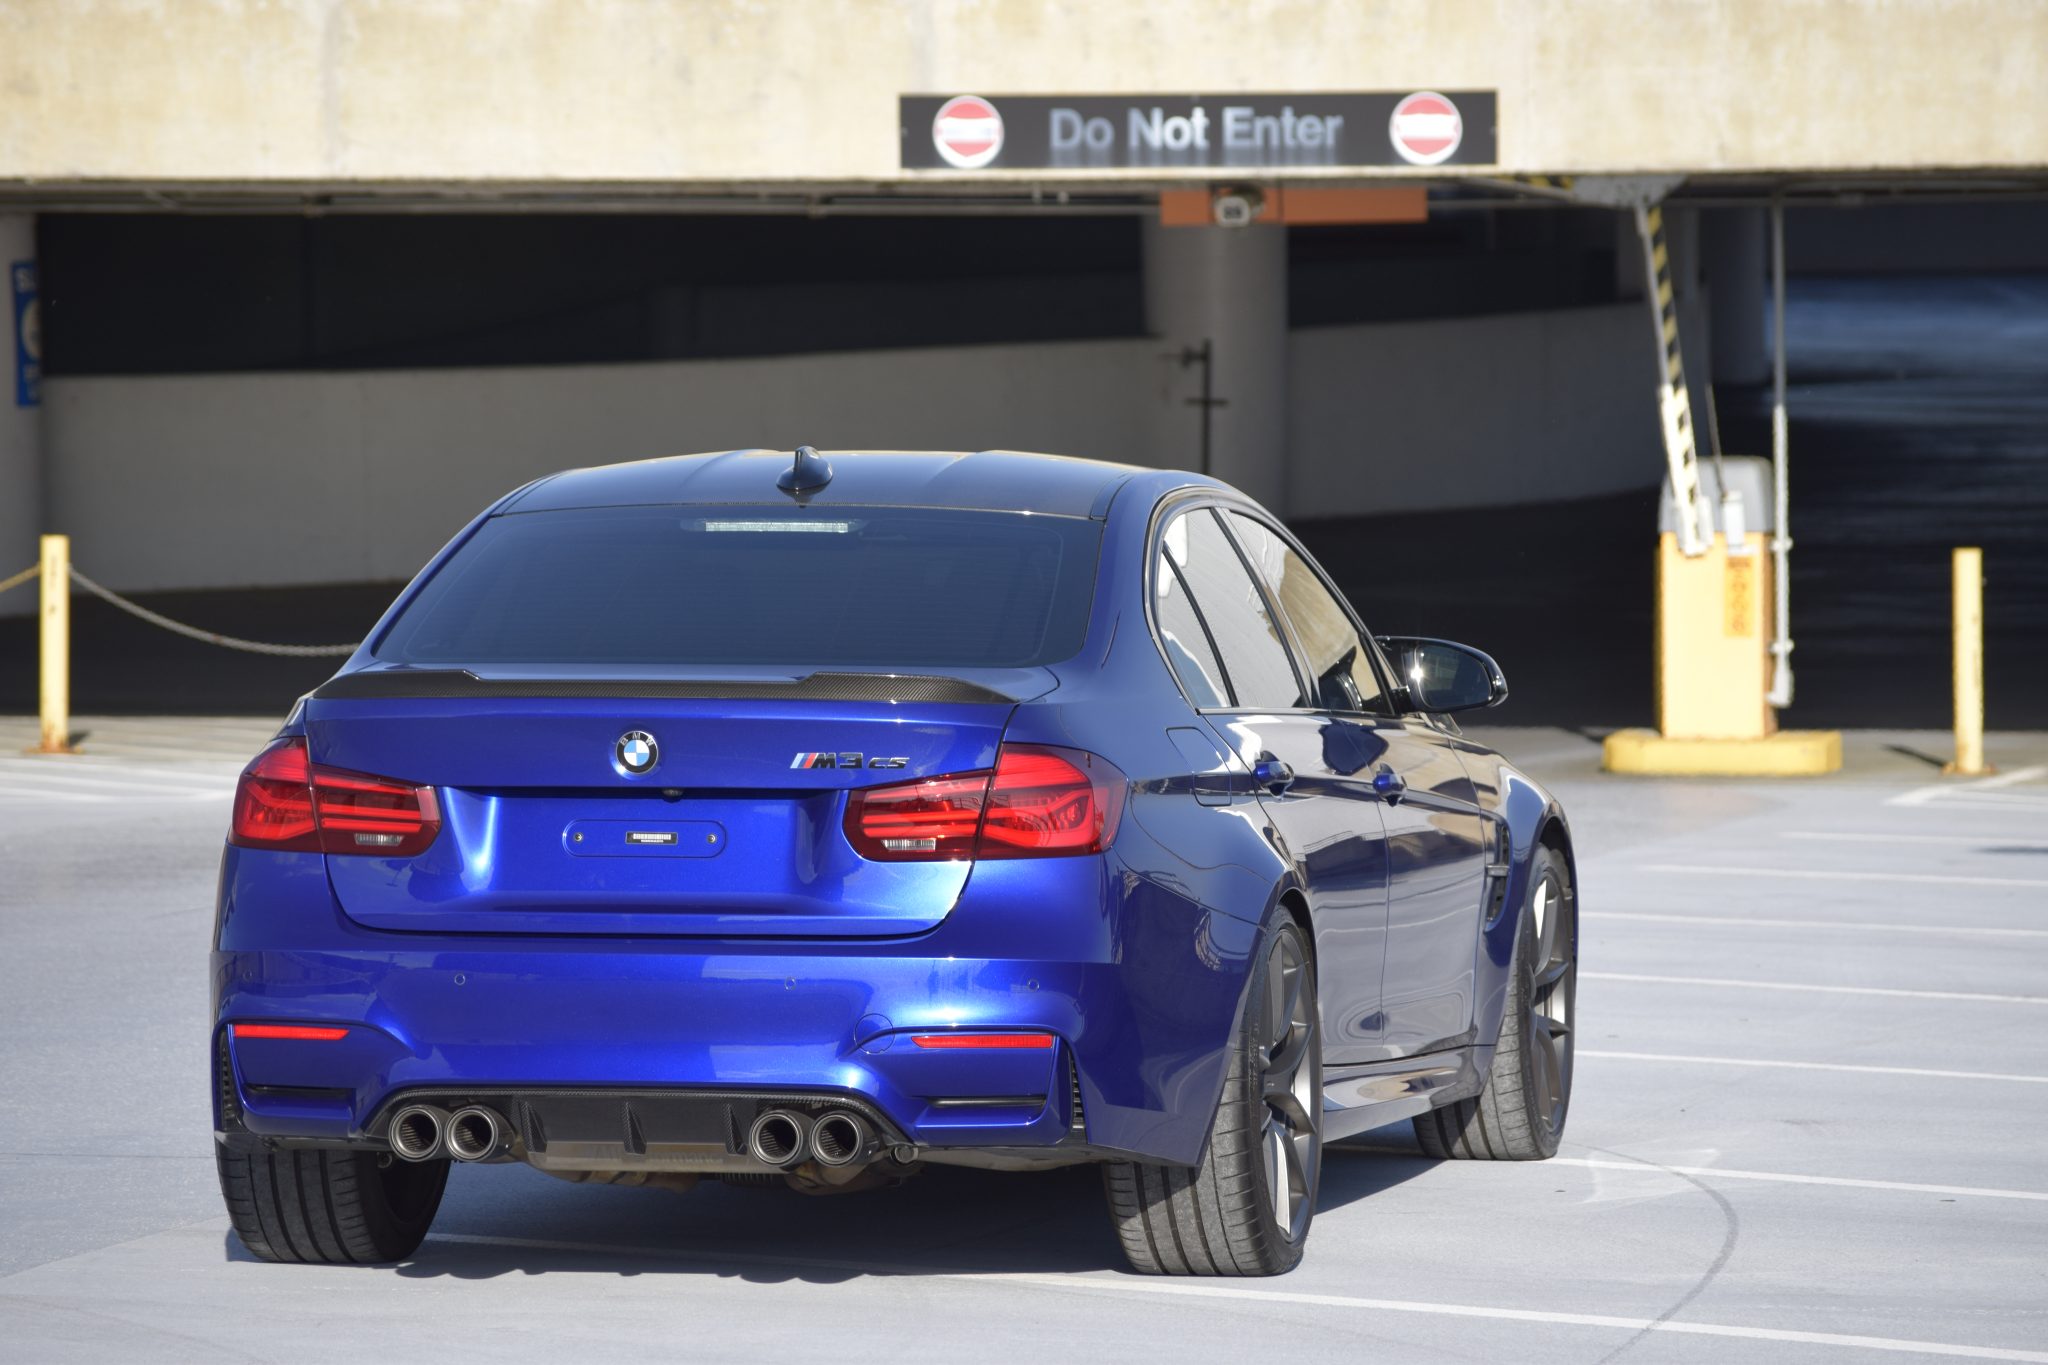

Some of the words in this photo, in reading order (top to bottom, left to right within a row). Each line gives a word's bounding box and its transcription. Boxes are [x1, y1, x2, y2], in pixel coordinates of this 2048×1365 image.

[1050, 107, 1115, 148] Do
[1128, 107, 1210, 149] Not
[1223, 106, 1344, 148] Enter
[619, 731, 655, 746] BMW
[810, 752, 863, 769] M3
